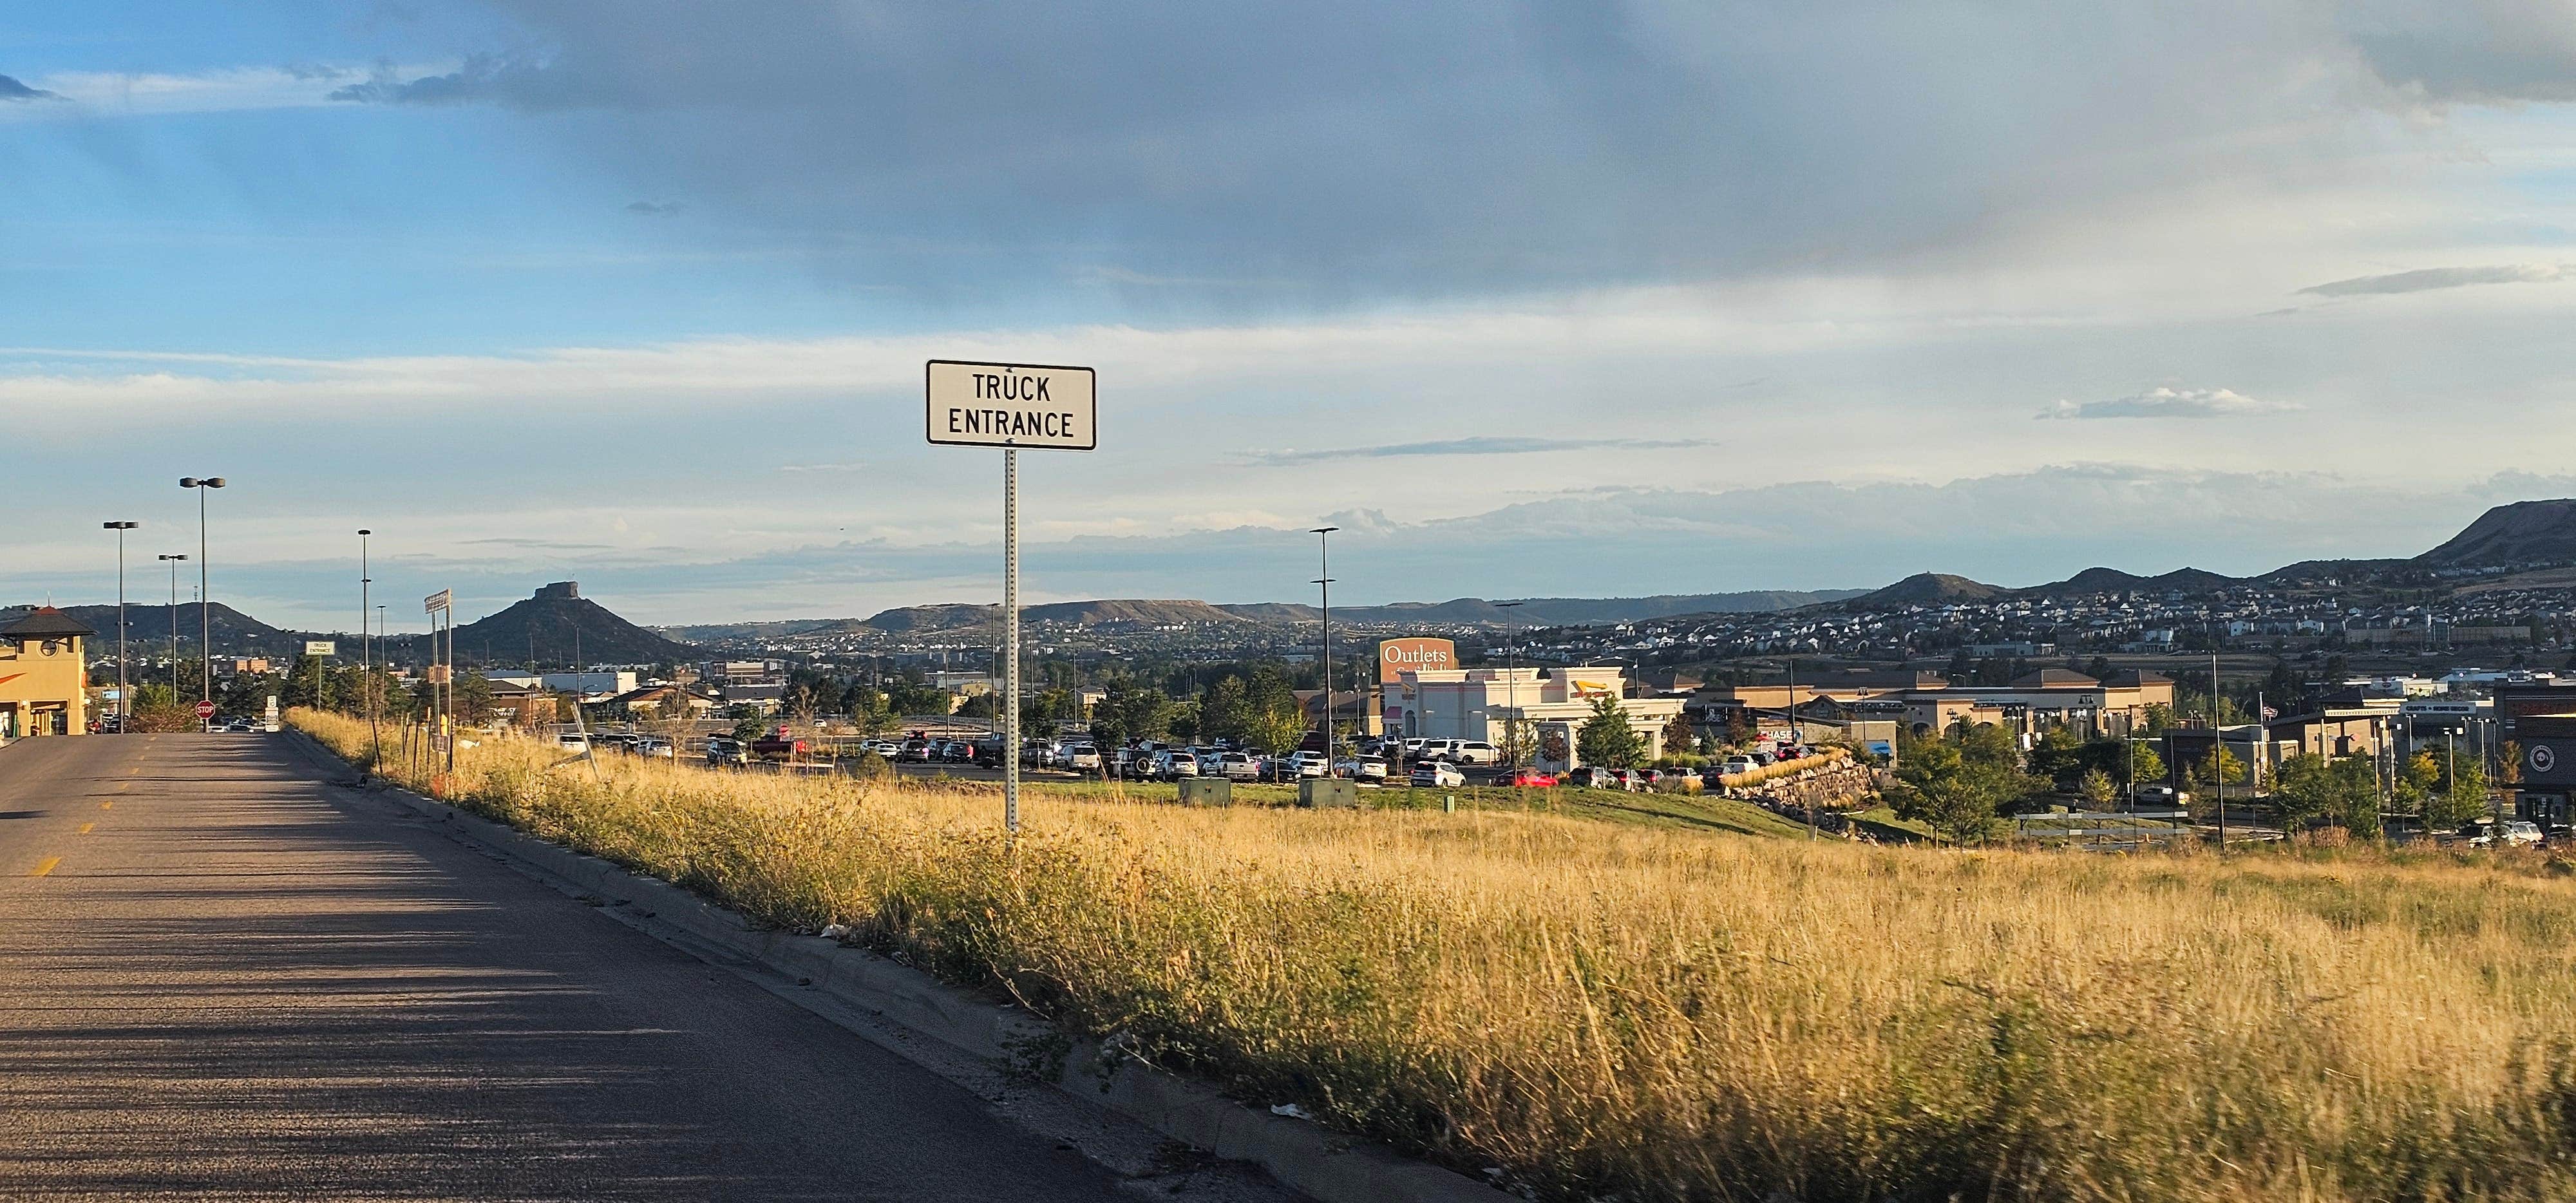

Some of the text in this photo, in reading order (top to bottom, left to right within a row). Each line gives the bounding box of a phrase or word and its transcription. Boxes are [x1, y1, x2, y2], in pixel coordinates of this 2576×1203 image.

[972, 374, 1050, 402] TRUCK
[949, 408, 1074, 438] ENTRANCE
[1385, 644, 1447, 663] Outlets
